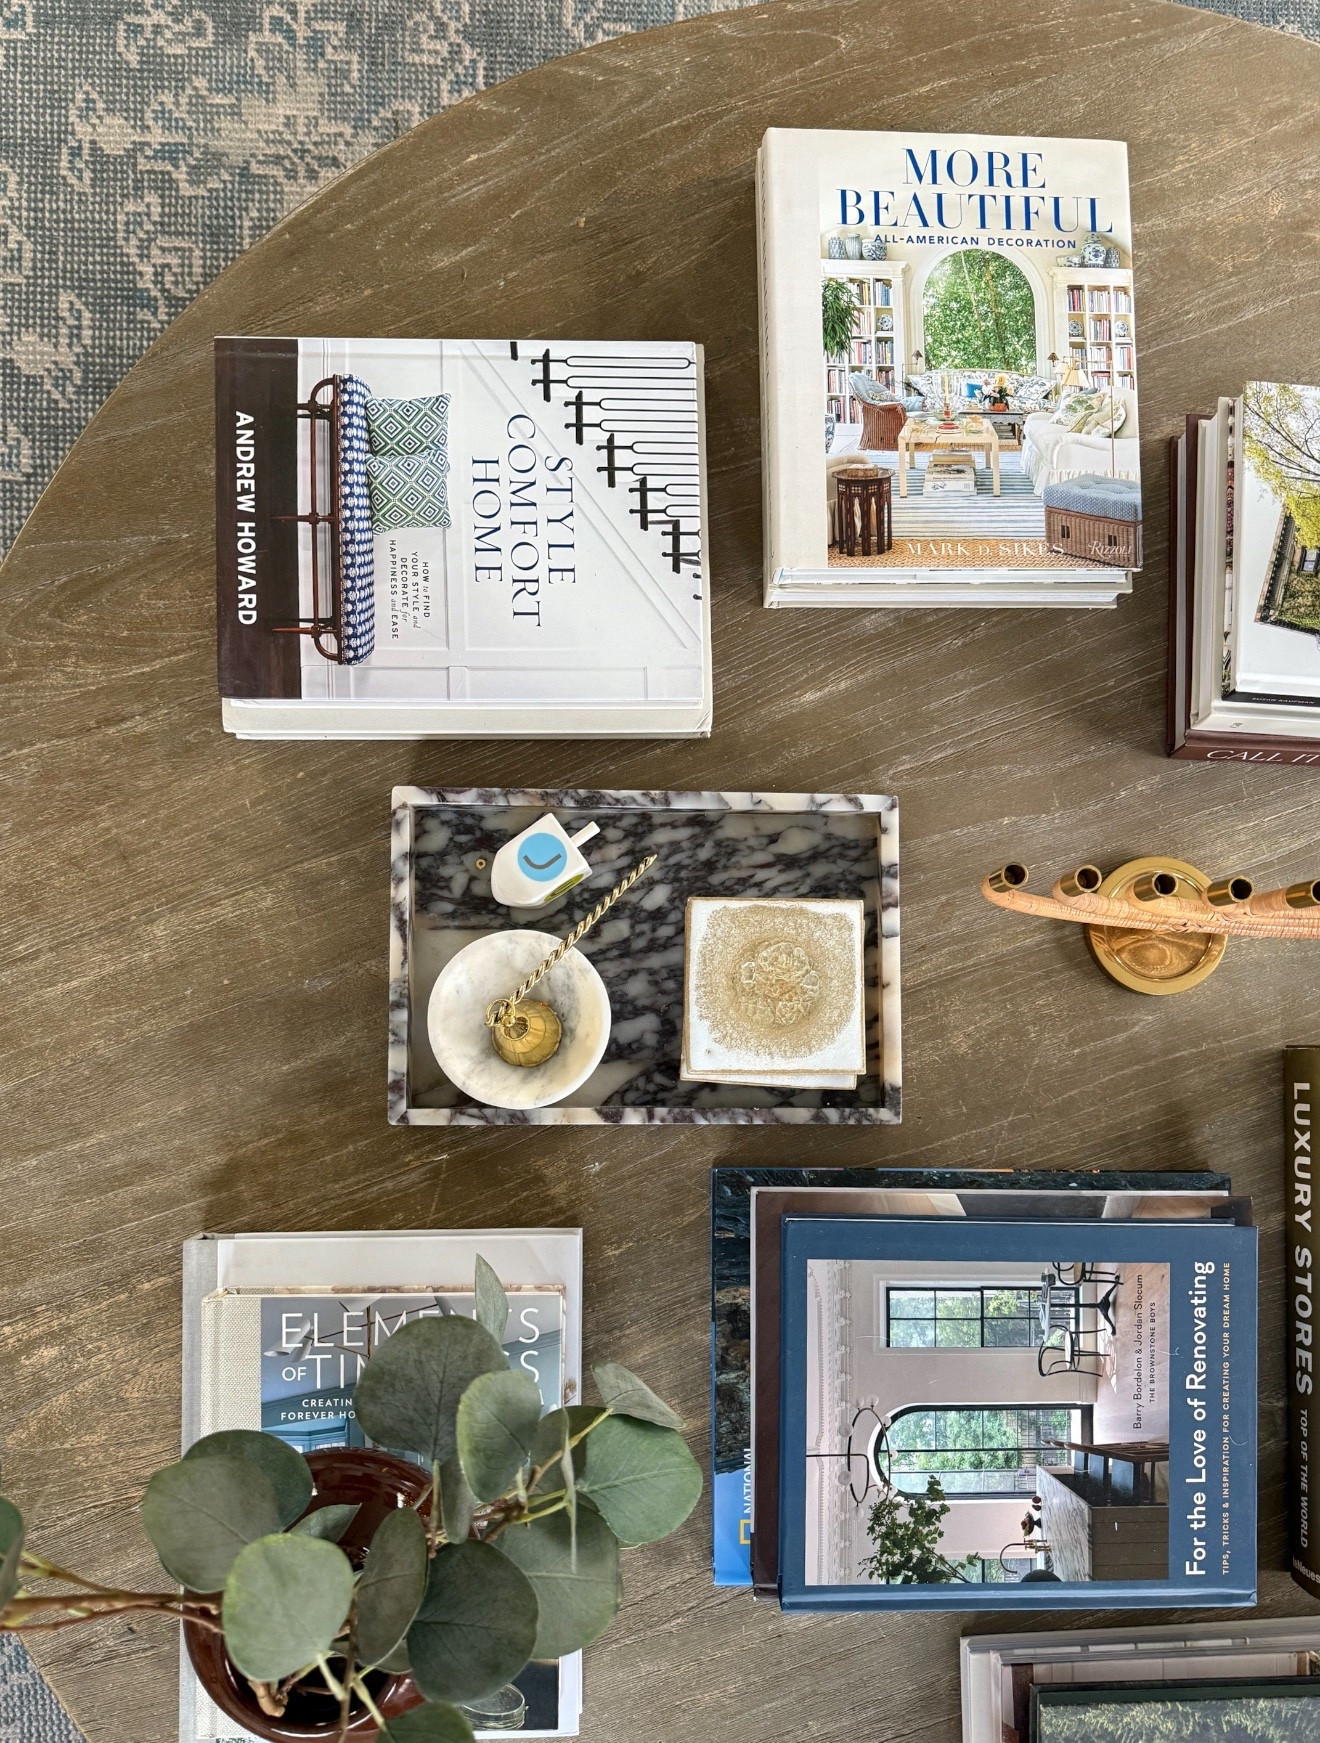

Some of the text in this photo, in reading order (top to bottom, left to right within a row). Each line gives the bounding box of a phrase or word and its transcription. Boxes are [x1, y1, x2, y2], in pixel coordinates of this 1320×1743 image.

[902, 147, 1046, 189] MORE
[836, 188, 1113, 234] BEAUTIFUL
[874, 234, 1077, 249] ALL-AMERICAN DECORATION
[234, 410, 257, 625] ANDREW HOWARD
[472, 455, 504, 583] HOME
[507, 413, 542, 627] COMFORT
[545, 455, 576, 585] STYLE
[389, 540, 397, 595] HAPPINESS
[907, 542, 971, 557] MARK
[998, 542, 1066, 557] SIKES
[1088, 541, 1133, 559] RIZZOLI
[400, 610, 410, 622] for
[1207, 750, 1283, 762] CALL
[1294, 1082, 1313, 1396] LUXURY STORES
[1222, 1262, 1230, 1291] HOME
[1222, 1294, 1230, 1328] DREAM
[1133, 1274, 1144, 1429] Barry Bordelon & Jordan Slocum
[281, 1366, 307, 1382] OF
[280, 1411, 334, 1421] FOREVER
[302, 1398, 353, 1407] CREATIN
[1185, 1261, 1214, 1575] For the Love of Renovating
[1300, 1409, 1308, 1549] TOP OF THE WORLD
[1222, 1550, 1231, 1575] TIPS,
